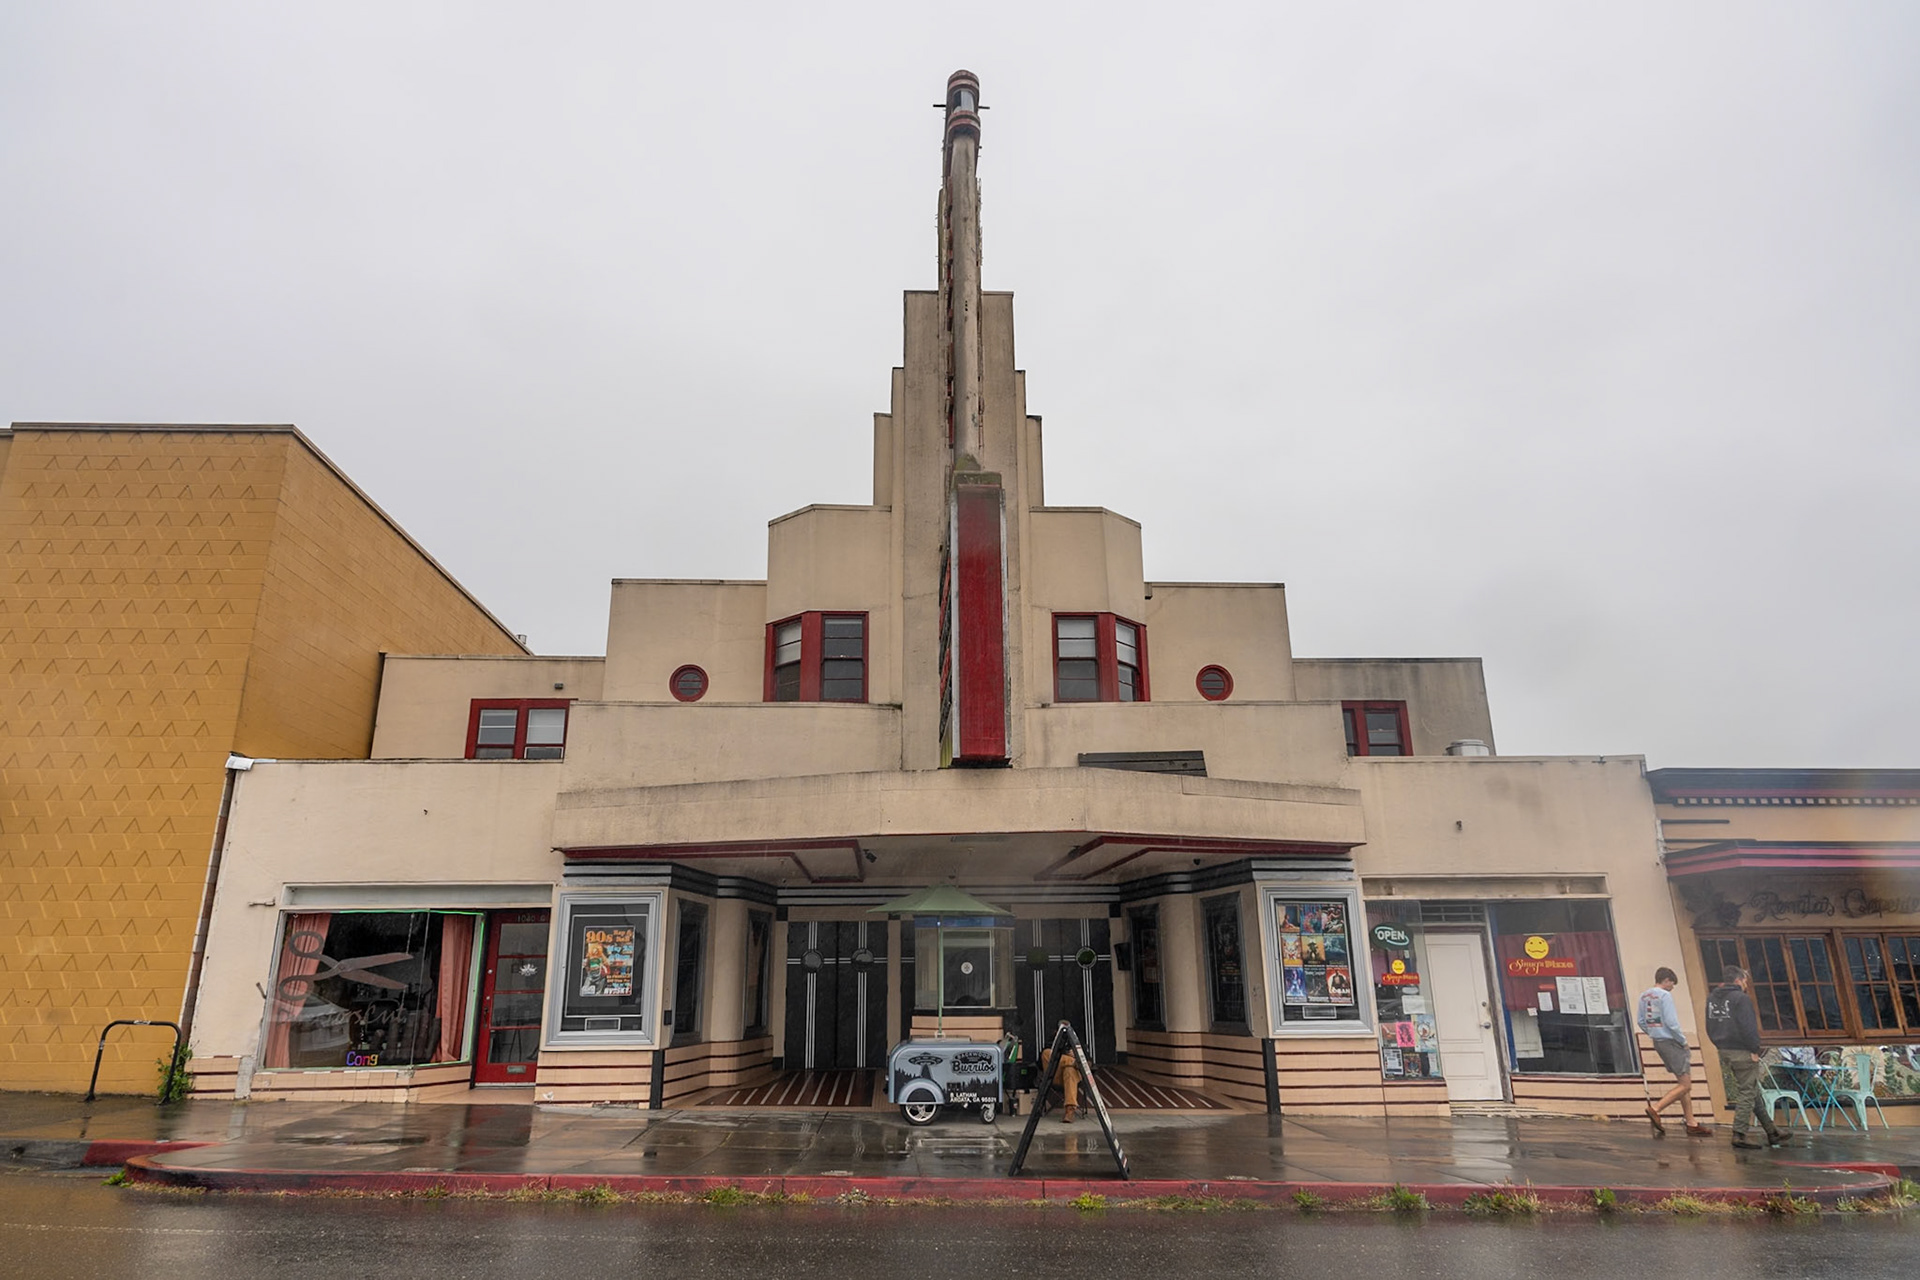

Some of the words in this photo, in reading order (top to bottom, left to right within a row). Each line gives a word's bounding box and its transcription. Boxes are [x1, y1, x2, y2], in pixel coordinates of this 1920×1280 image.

[586, 930, 613, 943] 90s
[1377, 930, 1405, 940] OPEN
[1545, 960, 1574, 969] Pizza
[346, 1051, 379, 1067] Cong
[952, 1060, 996, 1072] Burritos
